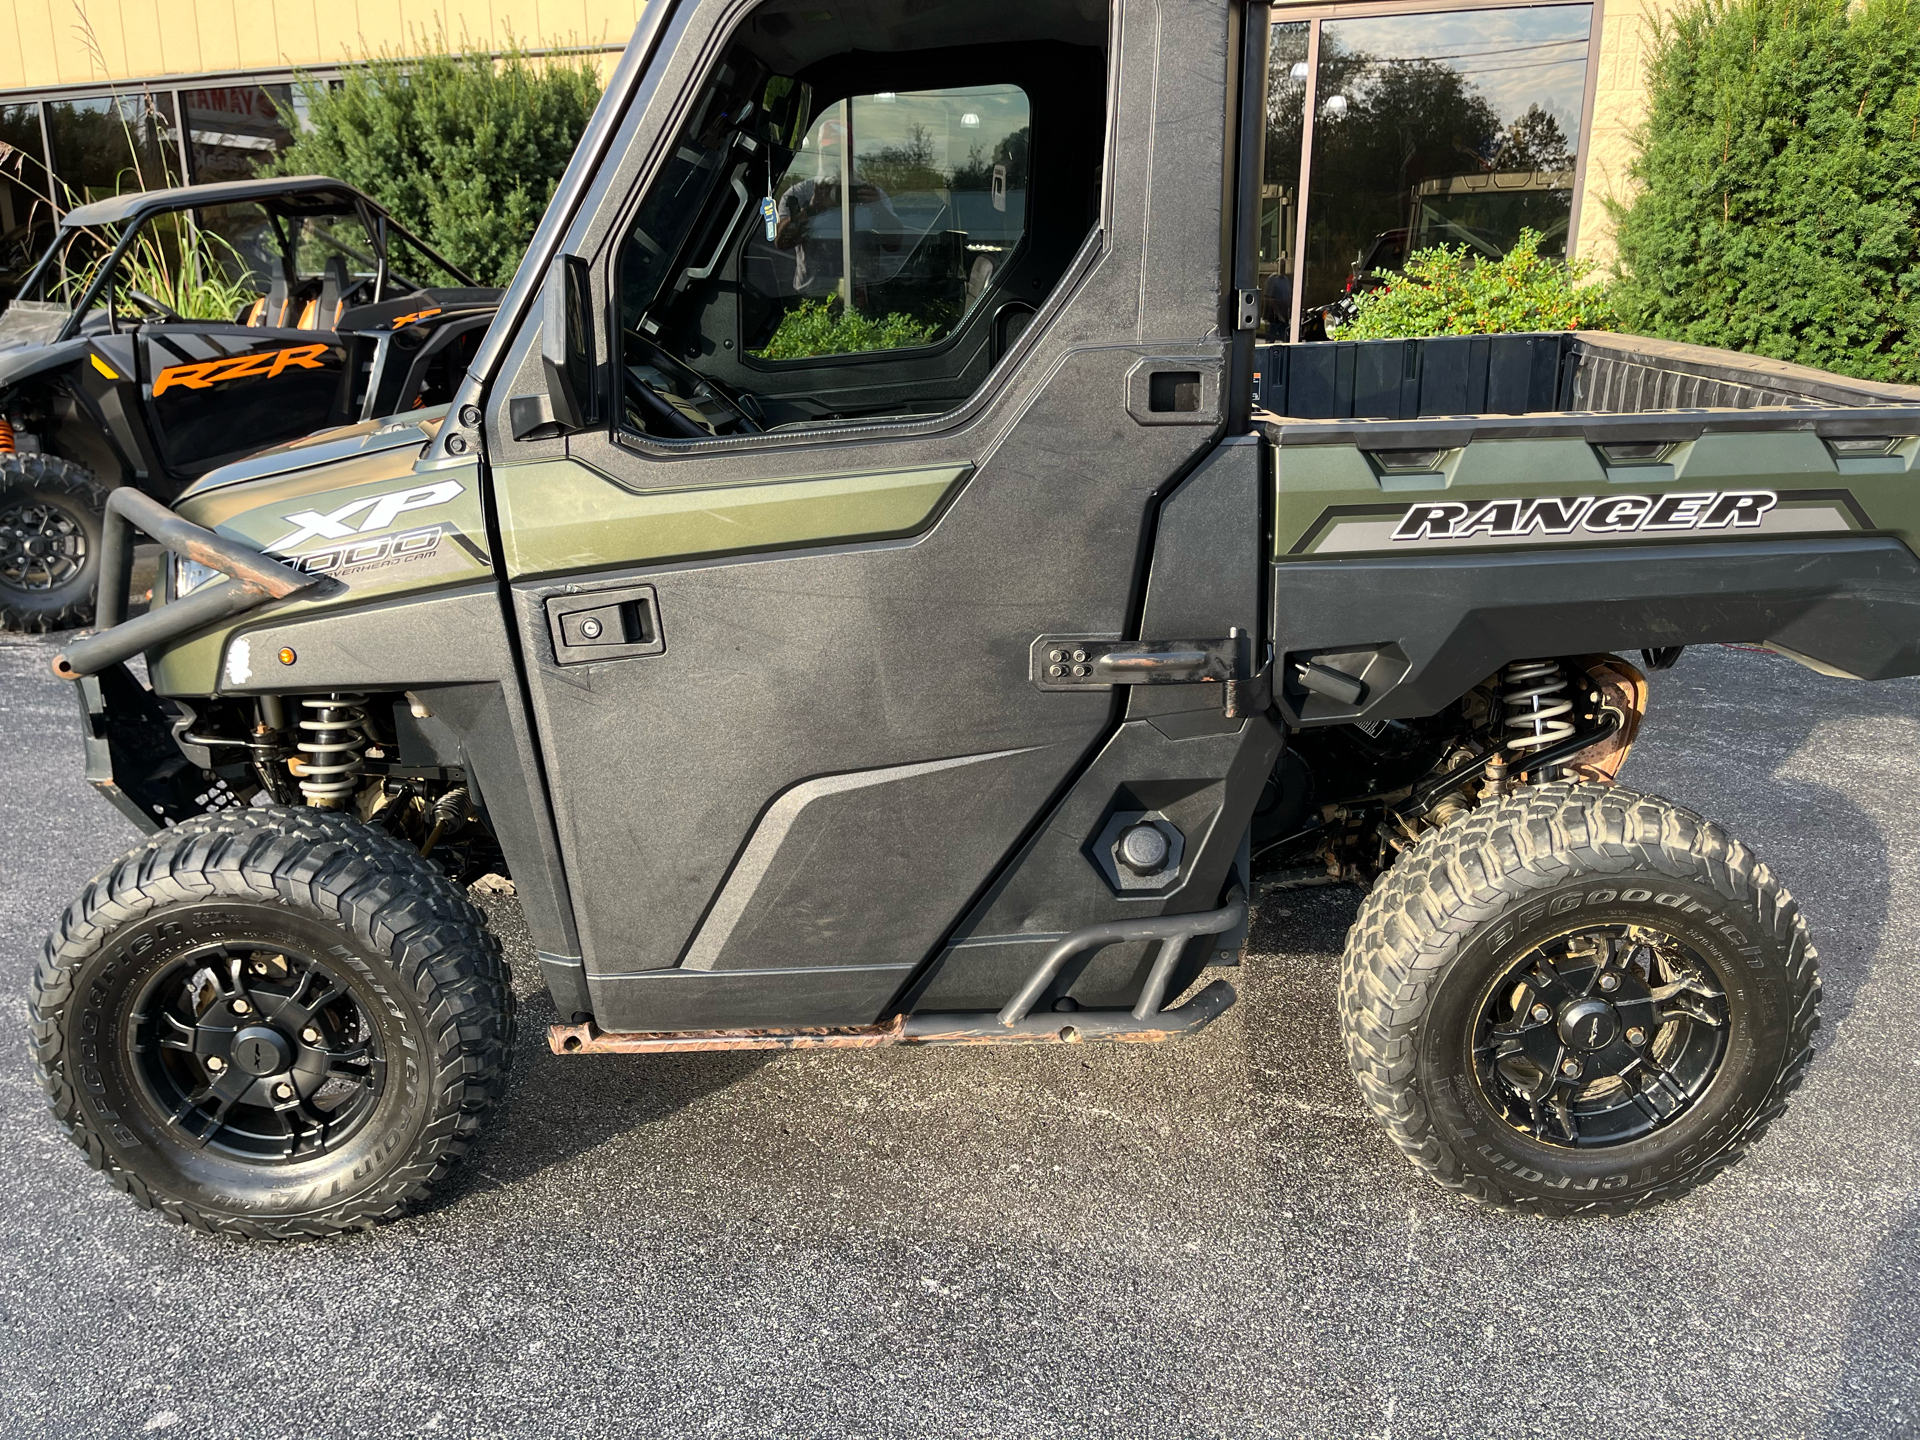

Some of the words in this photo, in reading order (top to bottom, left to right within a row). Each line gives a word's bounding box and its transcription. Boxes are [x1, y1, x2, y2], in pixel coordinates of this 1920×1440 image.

[153, 343, 329, 397] RZR
[261, 478, 467, 554] XP
[1389, 491, 1778, 539] RANGER
[404, 550, 437, 564] CAM
[1487, 888, 1764, 969] BFGoodrich
[78, 921, 183, 1148] BFGoodrich
[327, 944, 420, 1181] Mud-Terrain
